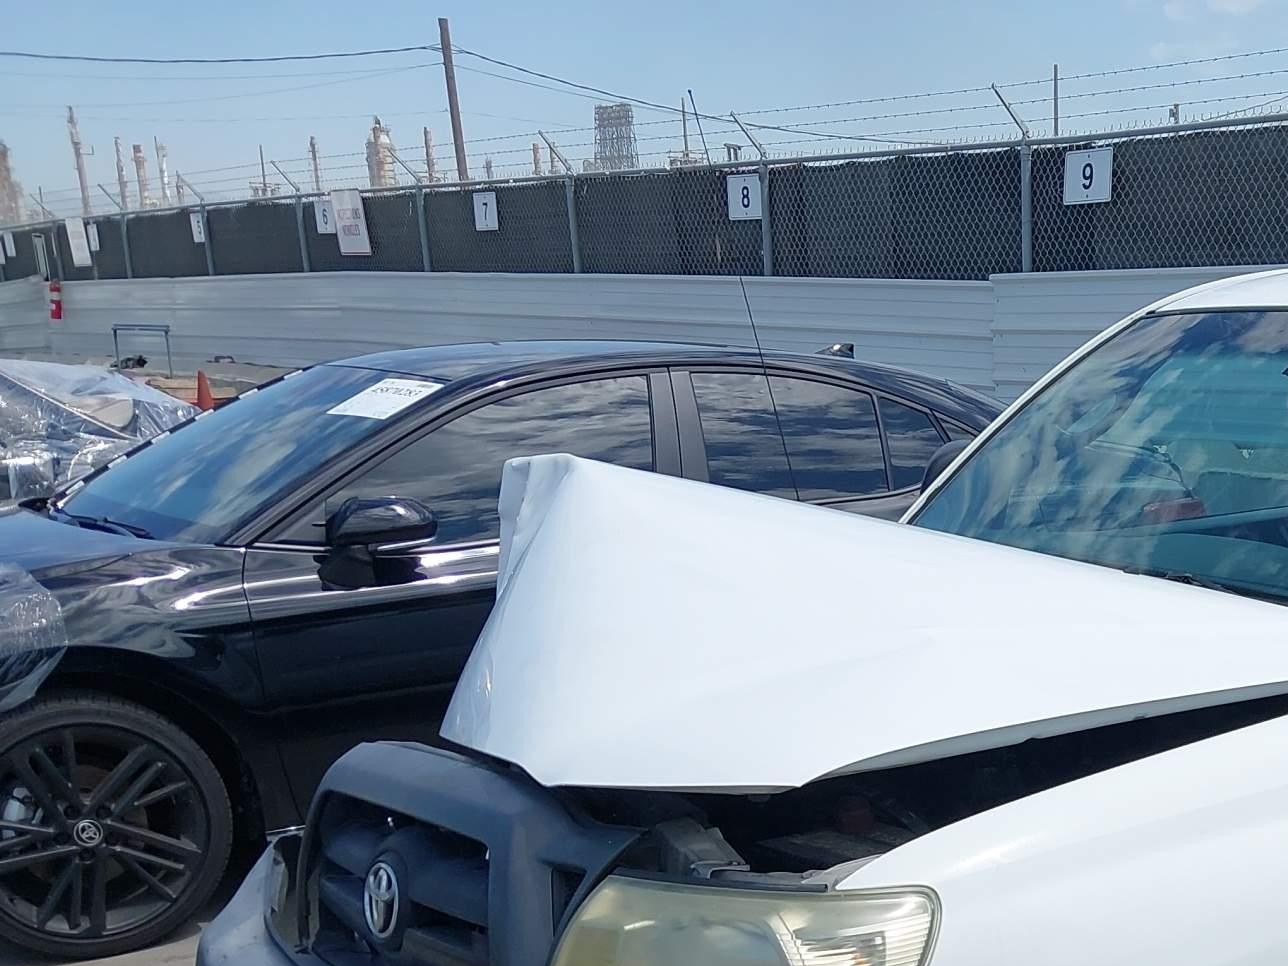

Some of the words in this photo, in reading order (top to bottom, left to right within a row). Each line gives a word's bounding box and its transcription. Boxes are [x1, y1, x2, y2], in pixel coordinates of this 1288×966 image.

[1081, 162, 1094, 190] 9
[741, 185, 751, 209] 8
[322, 208, 329, 225] 6
[482, 202, 488, 221] 7
